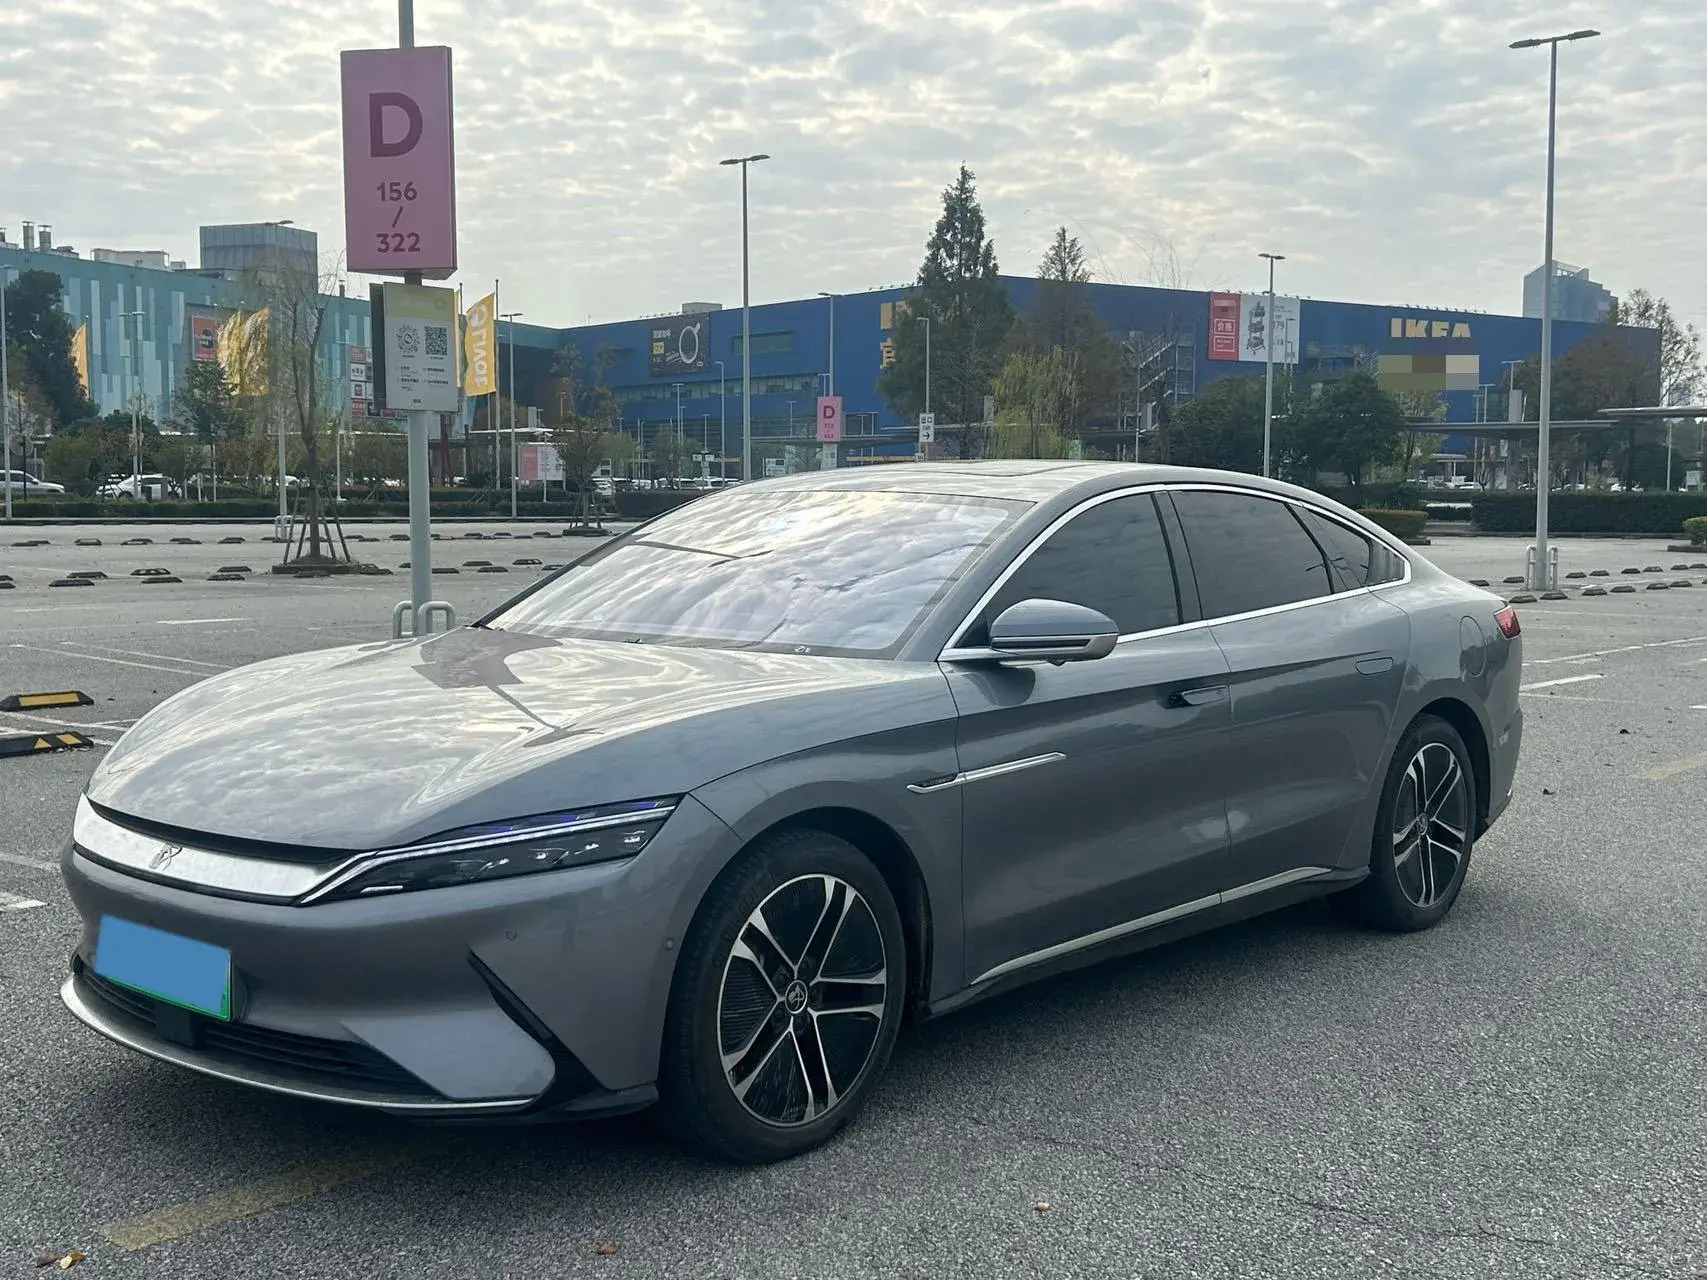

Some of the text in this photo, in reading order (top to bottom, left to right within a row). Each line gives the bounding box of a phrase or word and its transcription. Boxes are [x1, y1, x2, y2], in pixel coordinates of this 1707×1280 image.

[369, 91, 423, 158] D
[376, 180, 418, 202] 156
[376, 232, 421, 253] 322
[1391, 317, 1472, 338] IKEA
[823, 405, 836, 419] D
